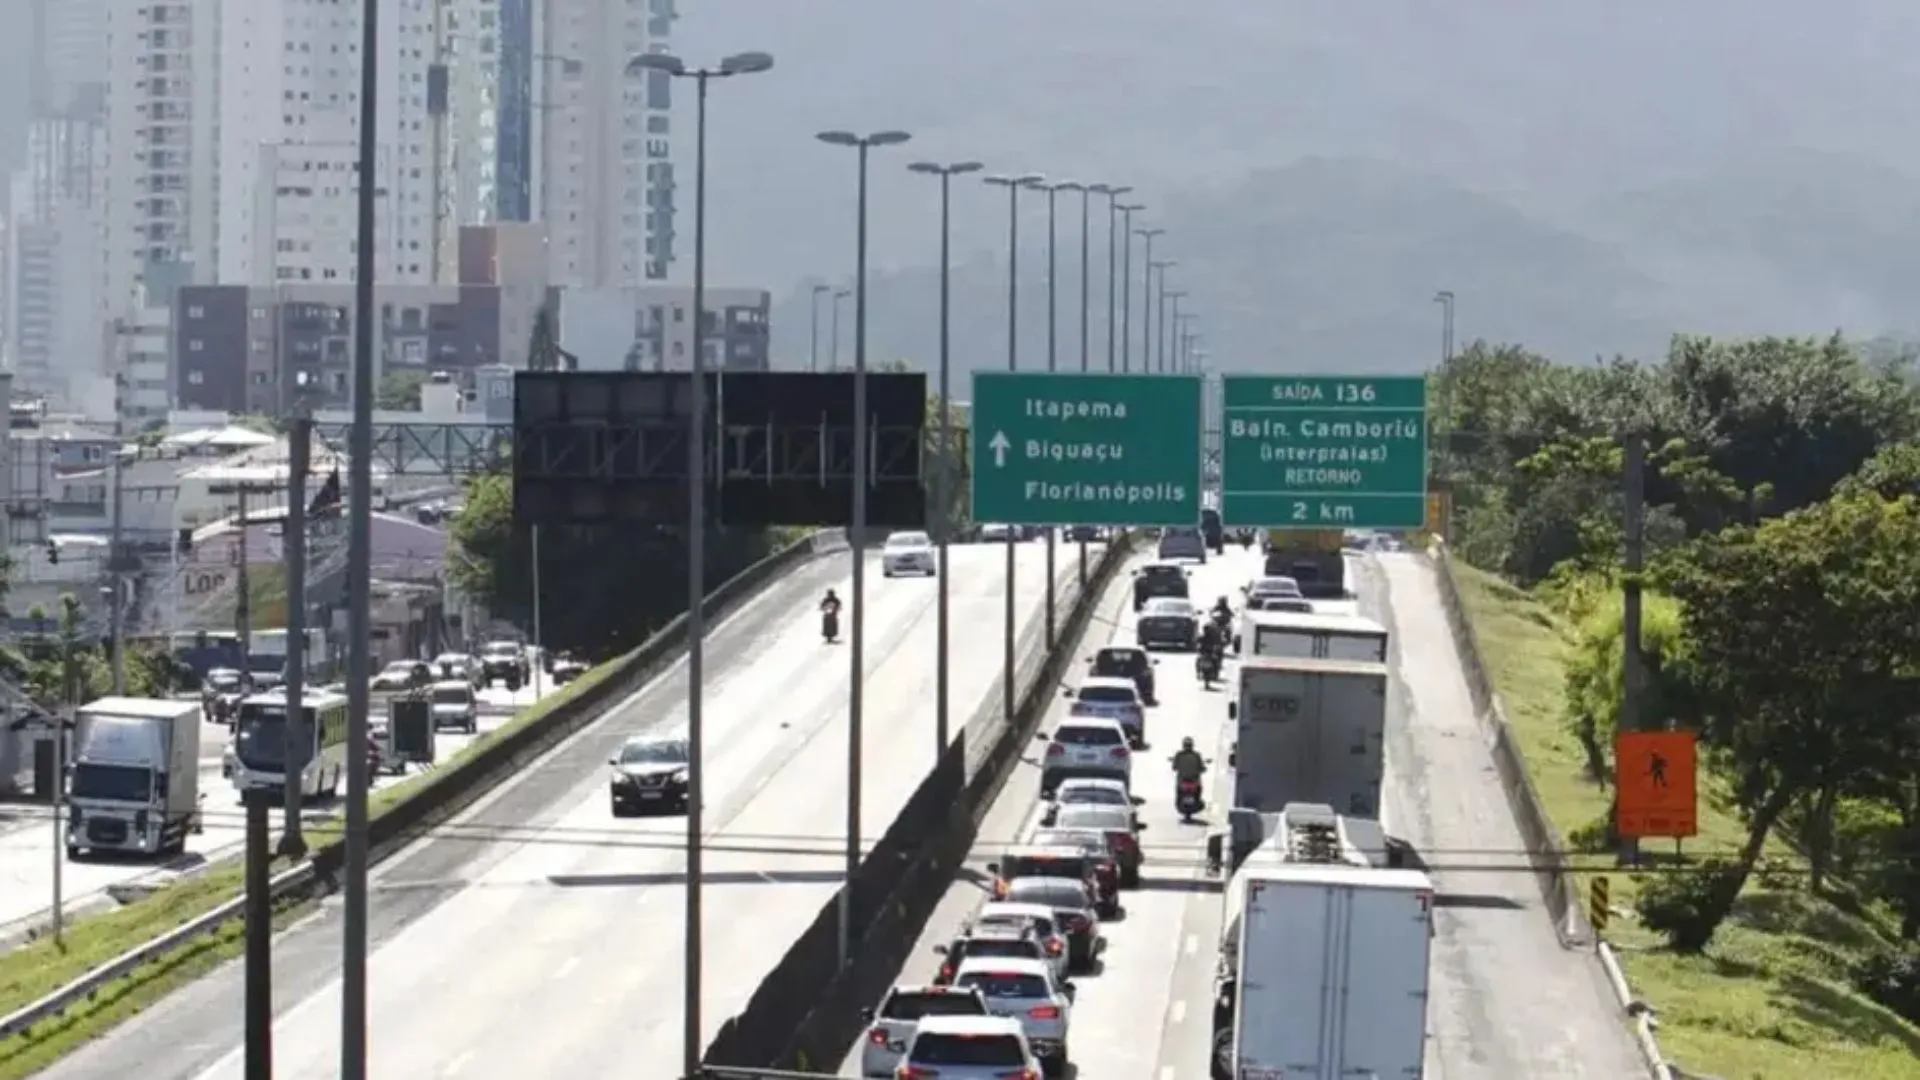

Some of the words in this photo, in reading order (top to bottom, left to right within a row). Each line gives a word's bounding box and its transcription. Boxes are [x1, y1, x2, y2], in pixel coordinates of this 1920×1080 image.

[1272, 382, 1324, 401] SAÍDA
[1336, 383, 1376, 403] 136
[1026, 399, 1127, 422] Itapema
[1301, 417, 1417, 439] Camboriú
[1026, 440, 1123, 463] Biguaçu
[1286, 467, 1362, 485] RETORNO
[1026, 481, 1185, 504] Florianópolis
[1292, 501, 1308, 520] 2
[1320, 502, 1354, 520] km
